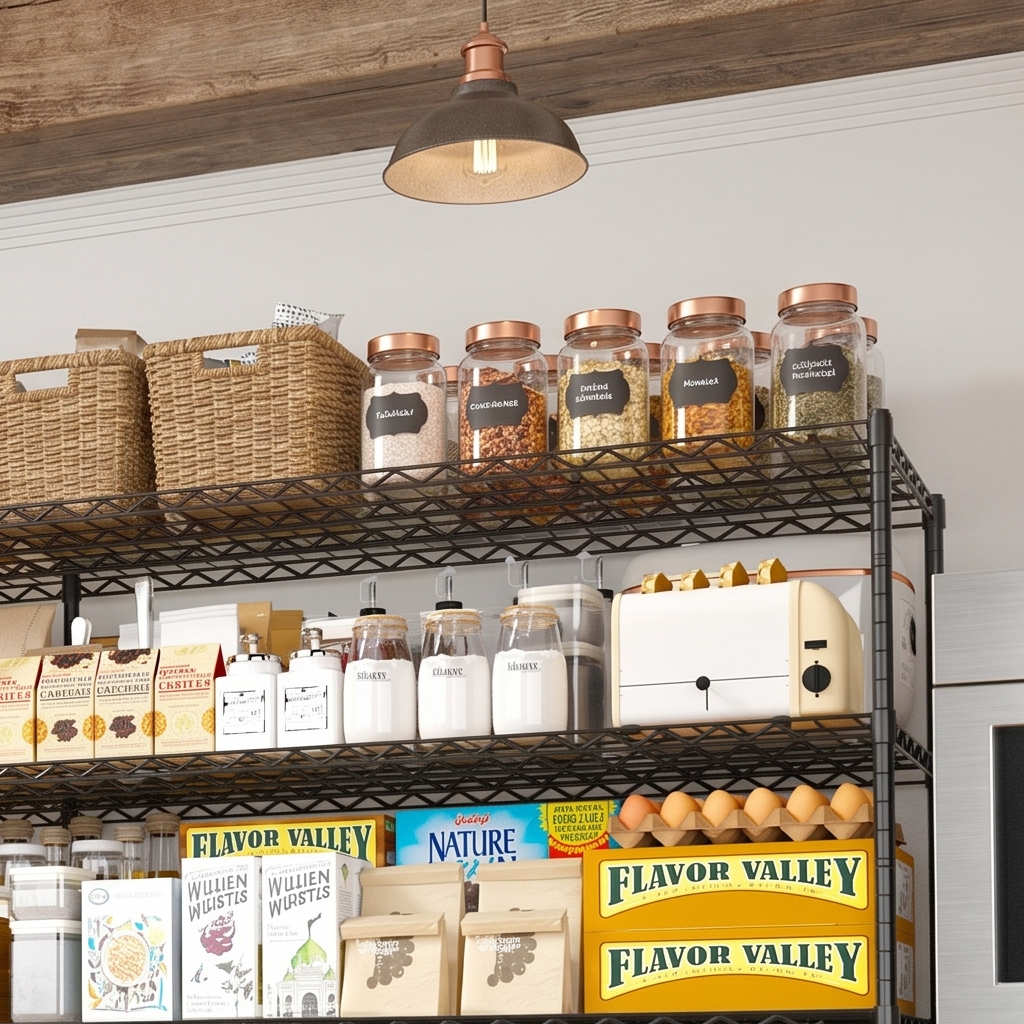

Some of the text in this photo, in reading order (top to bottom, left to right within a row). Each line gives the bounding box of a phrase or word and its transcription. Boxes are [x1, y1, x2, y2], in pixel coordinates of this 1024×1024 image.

[191, 824, 373, 863] FLAVOR VALLEY
[428, 828, 517, 865] NATURE
[607, 856, 862, 907] FLAVOR VALLEY
[607, 941, 863, 989] FLAVOR VALLEY
